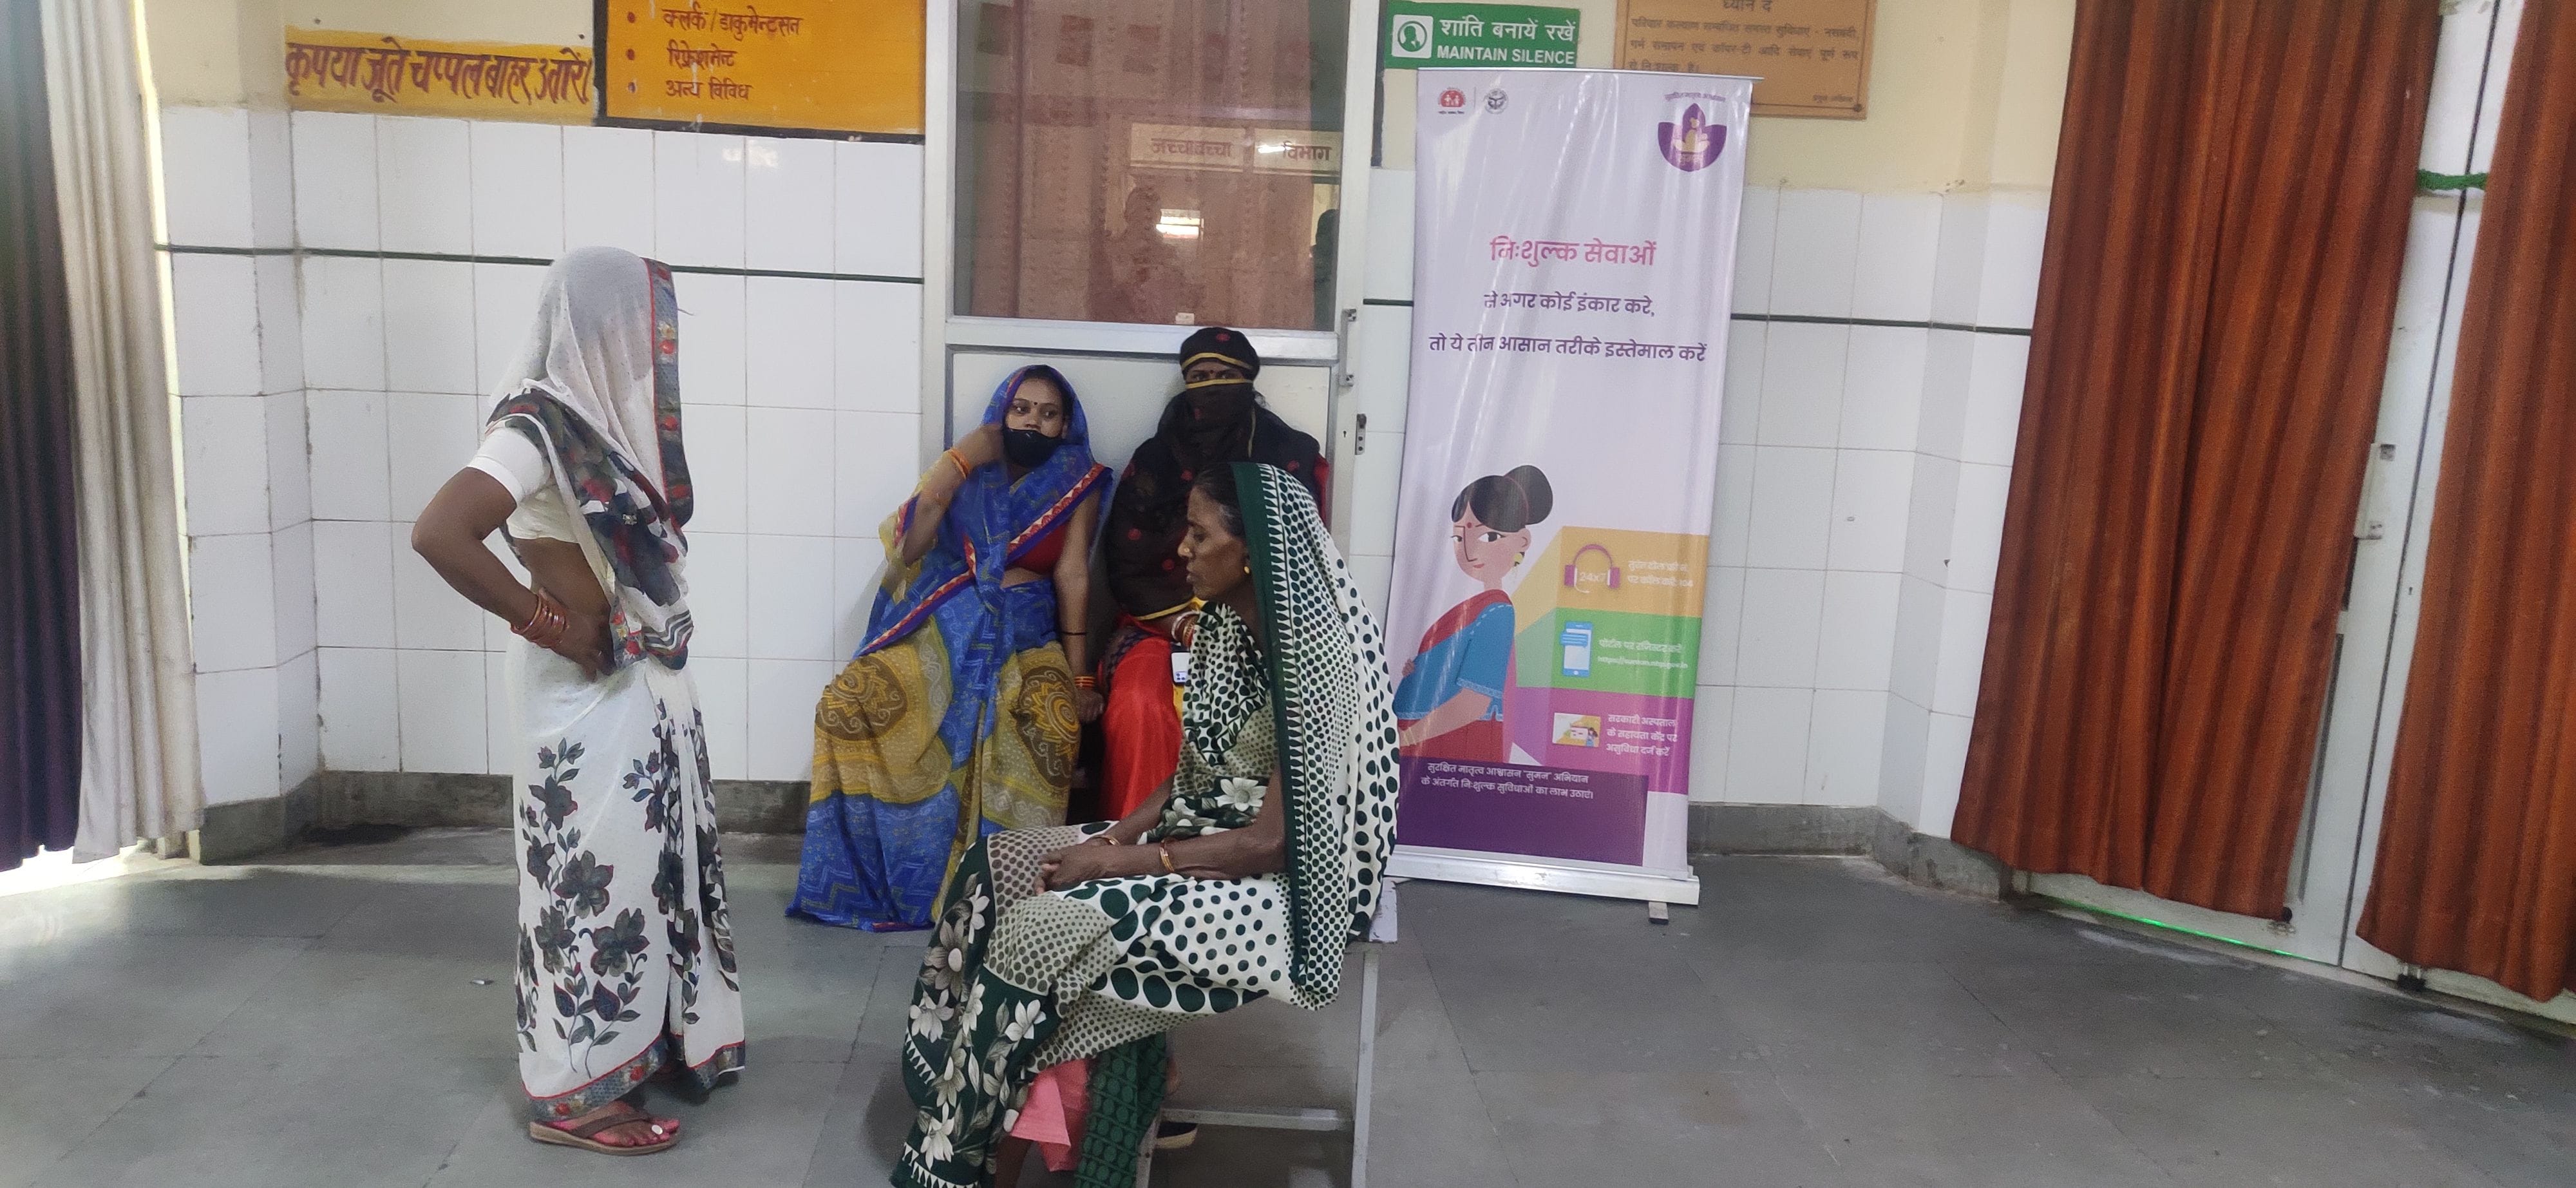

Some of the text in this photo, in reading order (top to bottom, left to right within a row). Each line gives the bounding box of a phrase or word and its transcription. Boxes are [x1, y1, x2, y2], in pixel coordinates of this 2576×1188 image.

[1439, 14, 1576, 42] शांति बनायें रखें
[1437, 45, 1575, 64] MAINTAIN SILENCE
[285, 43, 363, 96] कृपया
[361, 37, 413, 103] जूते
[408, 51, 492, 99] चप्पल
[486, 55, 539, 105] बाहर
[709, 76, 753, 100] विविध
[1584, 238, 1657, 266] सेवाओं
[1501, 292, 1537, 308] अगर
[1540, 291, 1576, 311] कोई
[1577, 293, 1621, 313] इंकार
[1428, 333, 1708, 362] तो ये तीन आसान तरीके इस्तेमाल करें
[1608, 714, 1676, 727] सरकारी अस्पताल
[1607, 727, 1616, 736] के
[1666, 733, 1678, 742] पर
[1427, 762, 1457, 773] सुरक्षित
[1458, 765, 1485, 777] मातृत्व
[1486, 767, 1522, 778] आश्वासन
[1553, 771, 1589, 784] अभियान
[1421, 775, 1431, 785] के
[1432, 777, 1459, 788] अंतर्गत
[1535, 785, 1548, 795] का
[1549, 787, 1569, 798] लाभ
